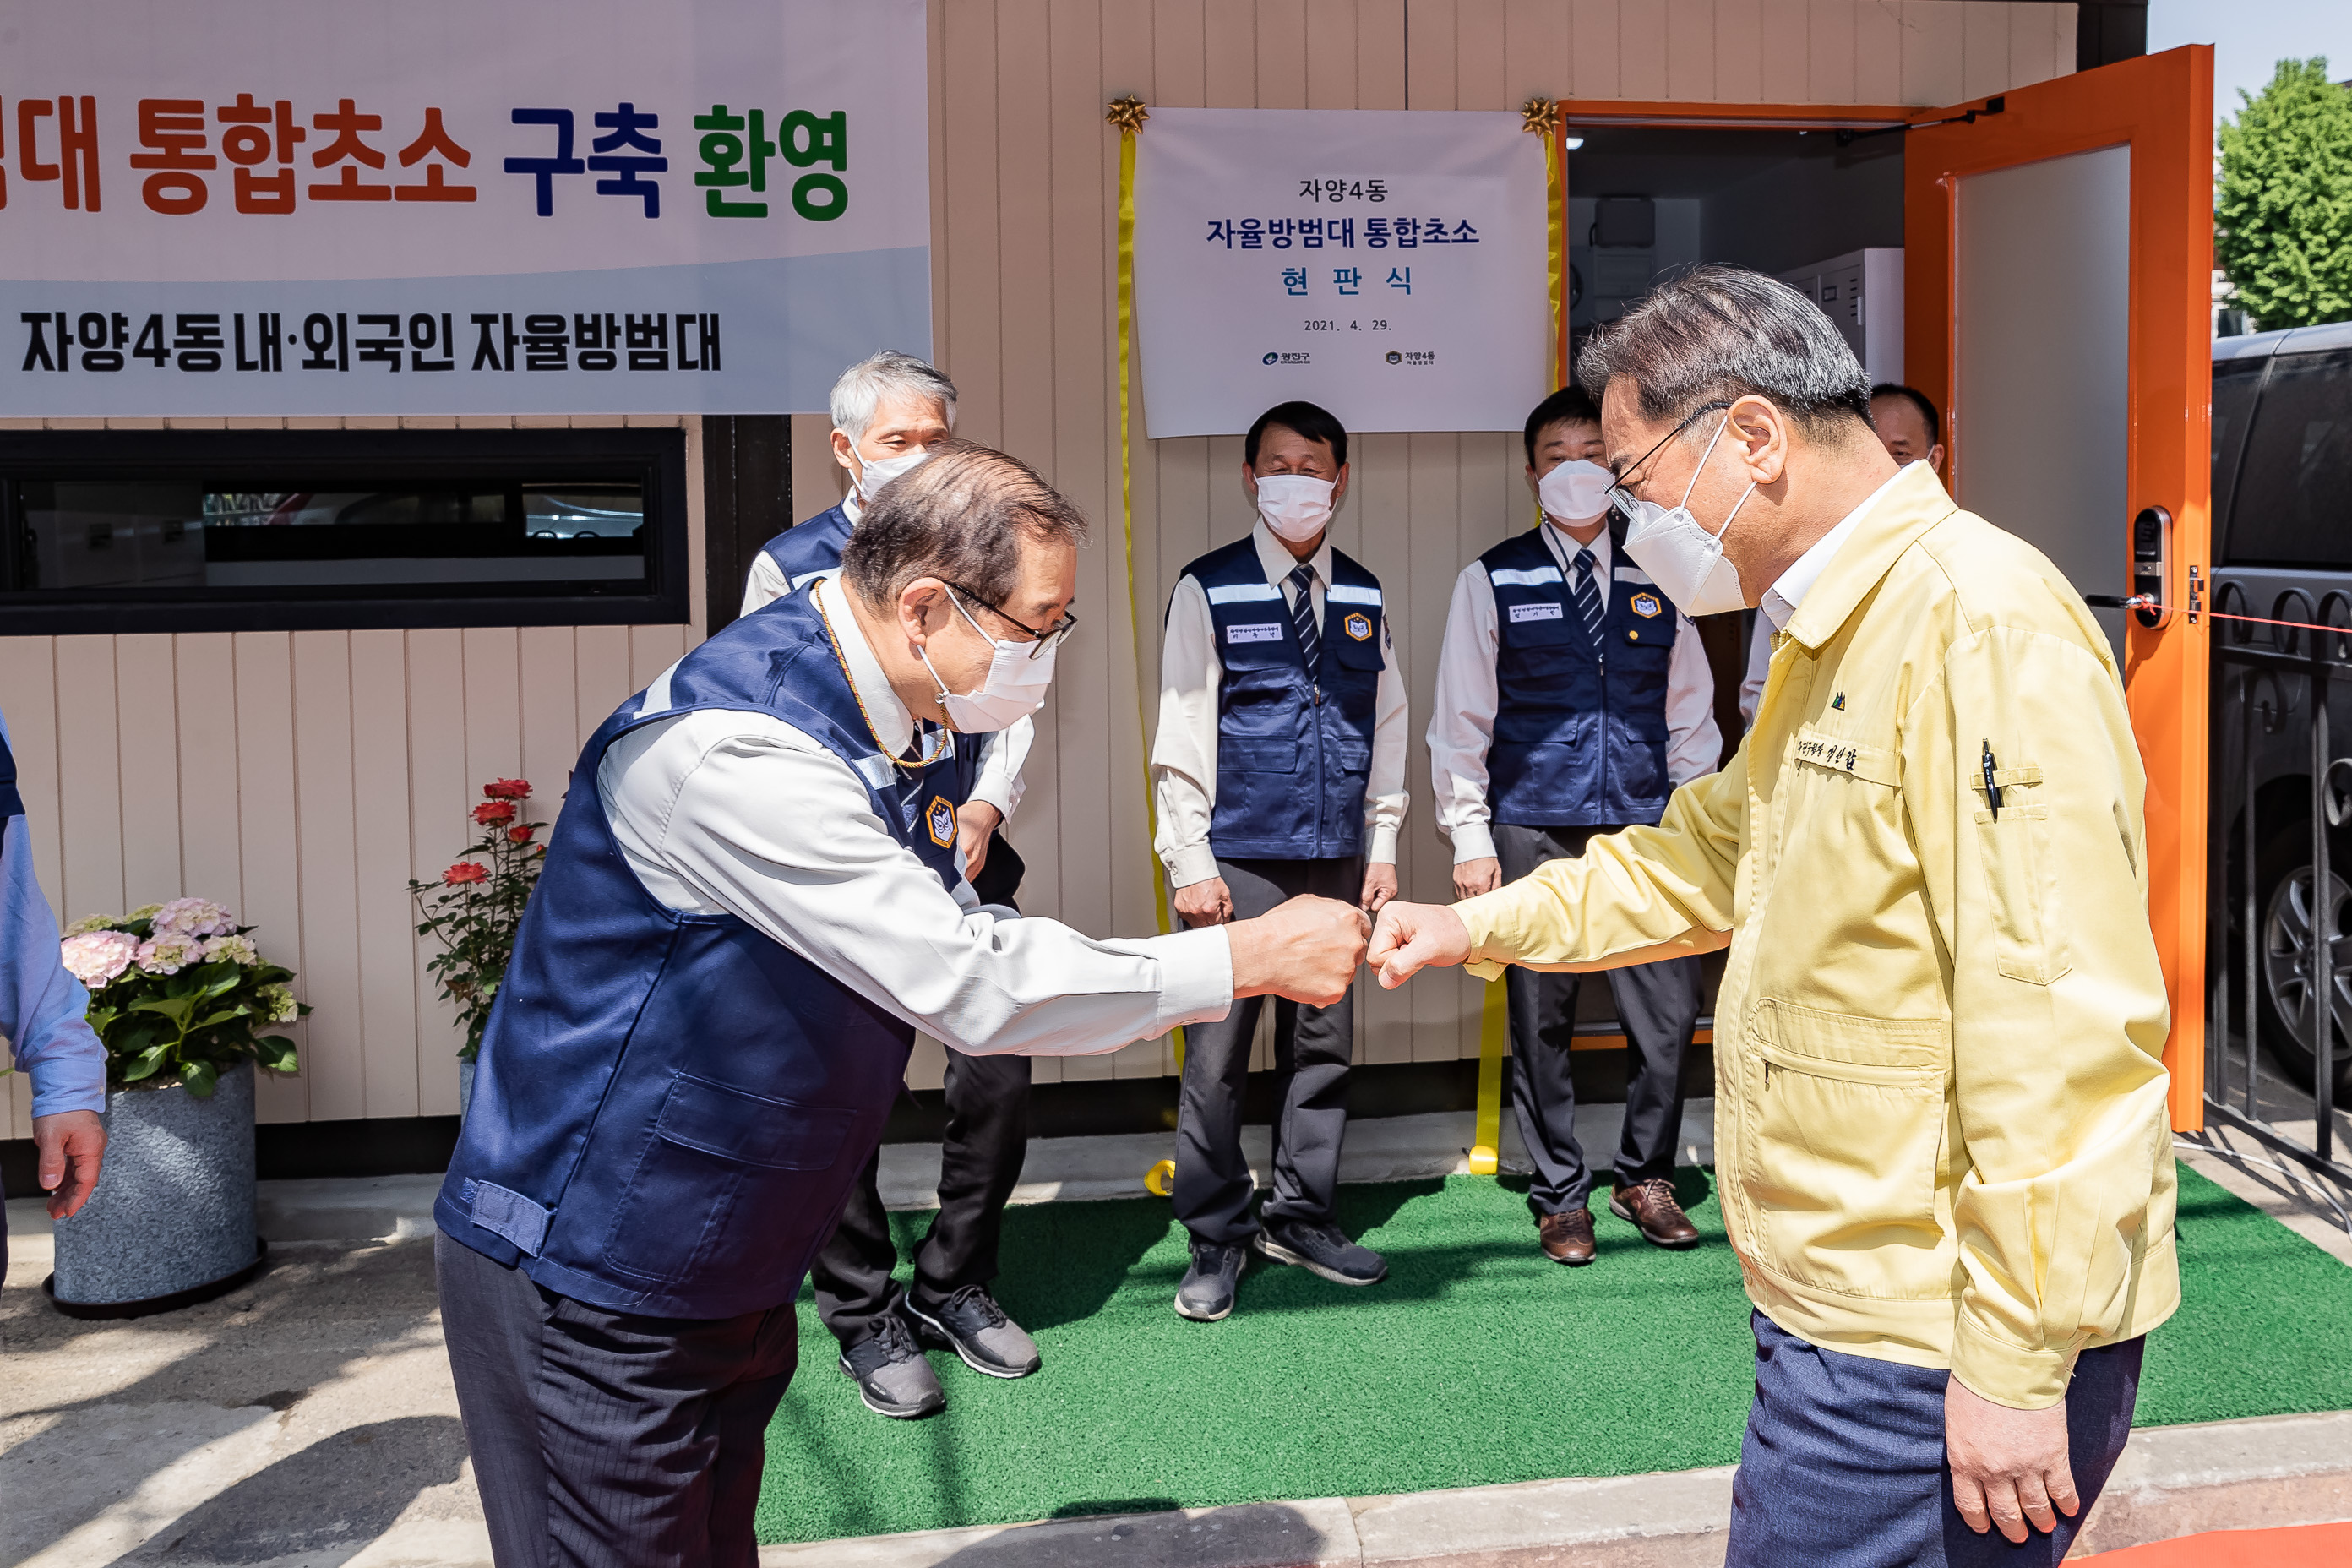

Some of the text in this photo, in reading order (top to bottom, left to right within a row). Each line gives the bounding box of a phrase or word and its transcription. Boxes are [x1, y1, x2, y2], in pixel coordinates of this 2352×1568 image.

[0, 93, 848, 221] 대 통합초소 구축 환영
[1298, 178, 1388, 203] 자양4동
[1206, 217, 1480, 250] 자율방범대 통합초소
[1304, 319, 1392, 332] 2021. 4. 29.
[470, 313, 721, 372] 자율방범대
[1404, 351, 1436, 361] 자양4동
